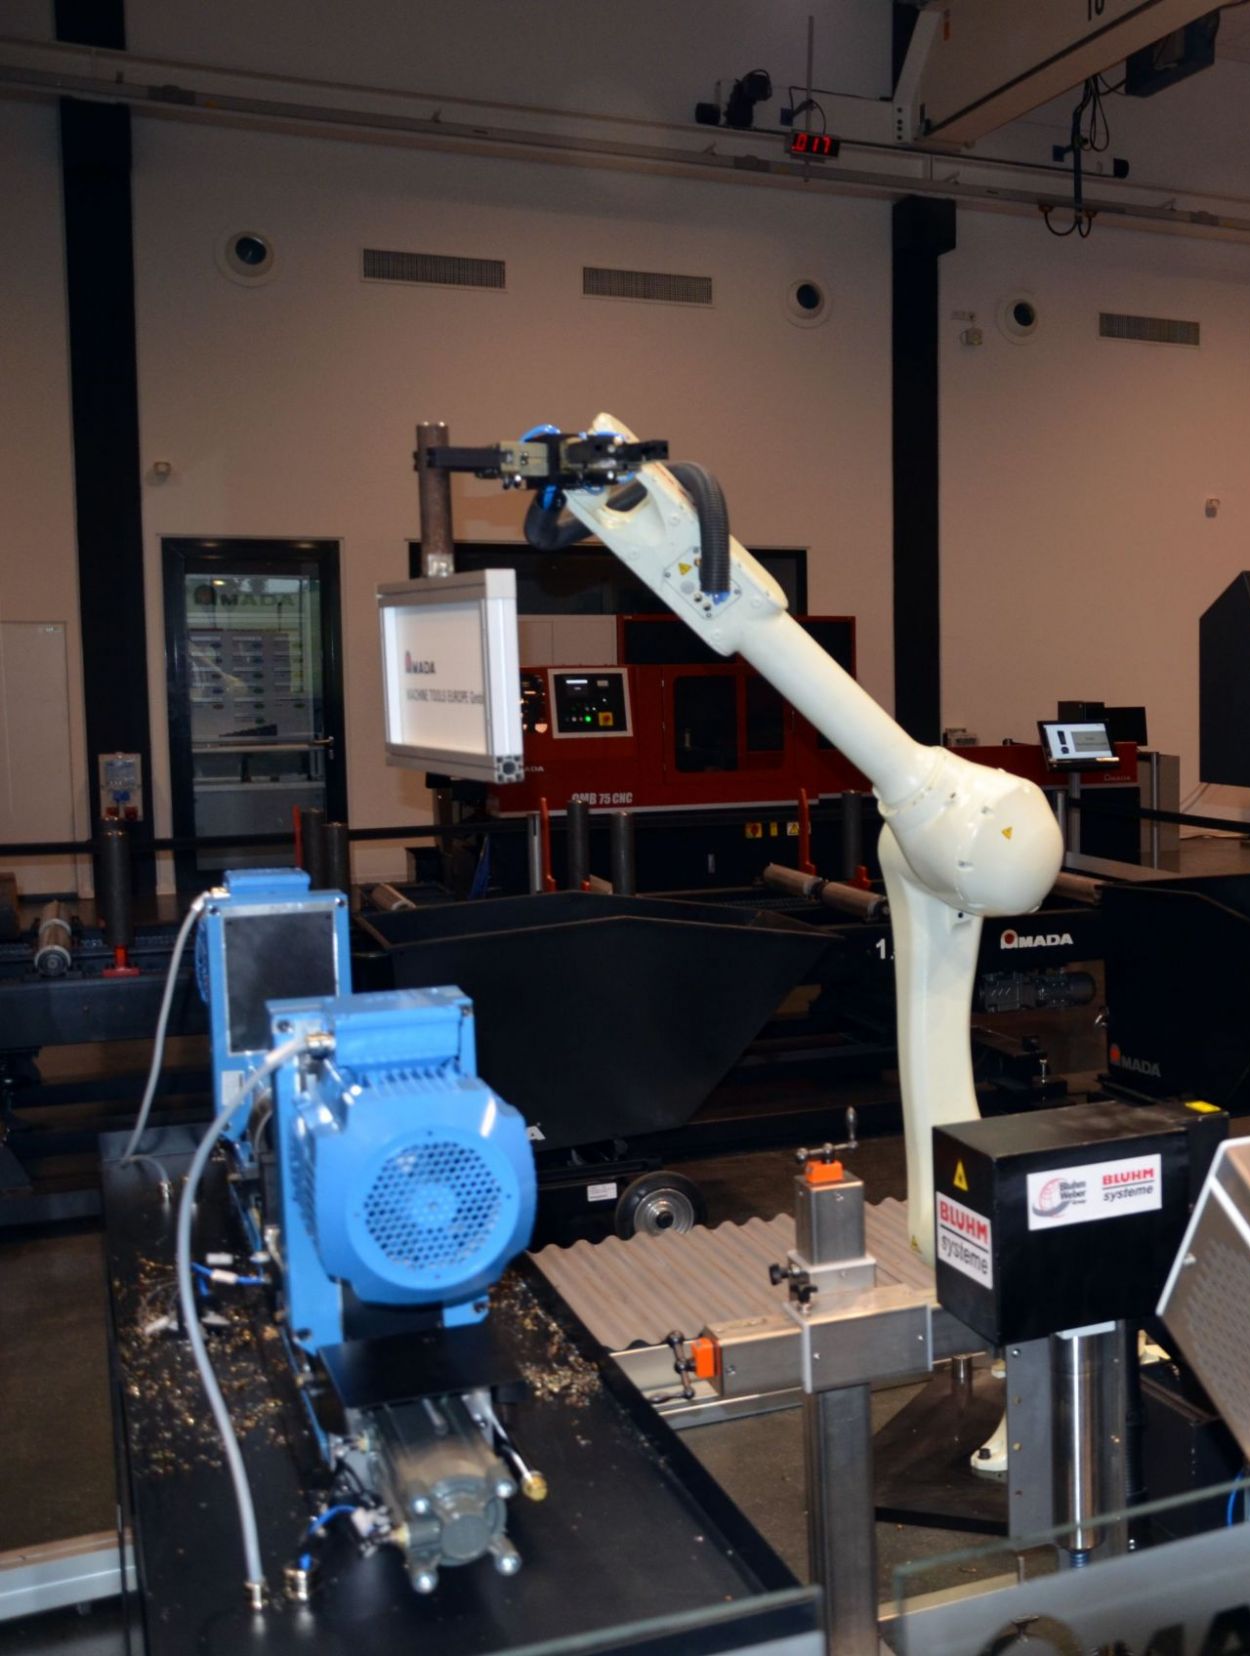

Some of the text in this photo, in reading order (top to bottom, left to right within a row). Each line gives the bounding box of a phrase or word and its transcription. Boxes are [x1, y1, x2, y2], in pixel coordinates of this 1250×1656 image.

[405, 650, 436, 674] AMADA
[599, 793, 611, 805] 75
[612, 792, 633, 804] CNC
[1000, 929, 1074, 949] AMADA
[1110, 1043, 1161, 1078] AMADA
[1102, 1167, 1154, 1186] BLUHM
[1103, 1185, 1154, 1202] systeme
[940, 1200, 989, 1246] BLUHM
[941, 1235, 988, 1275] systeme
